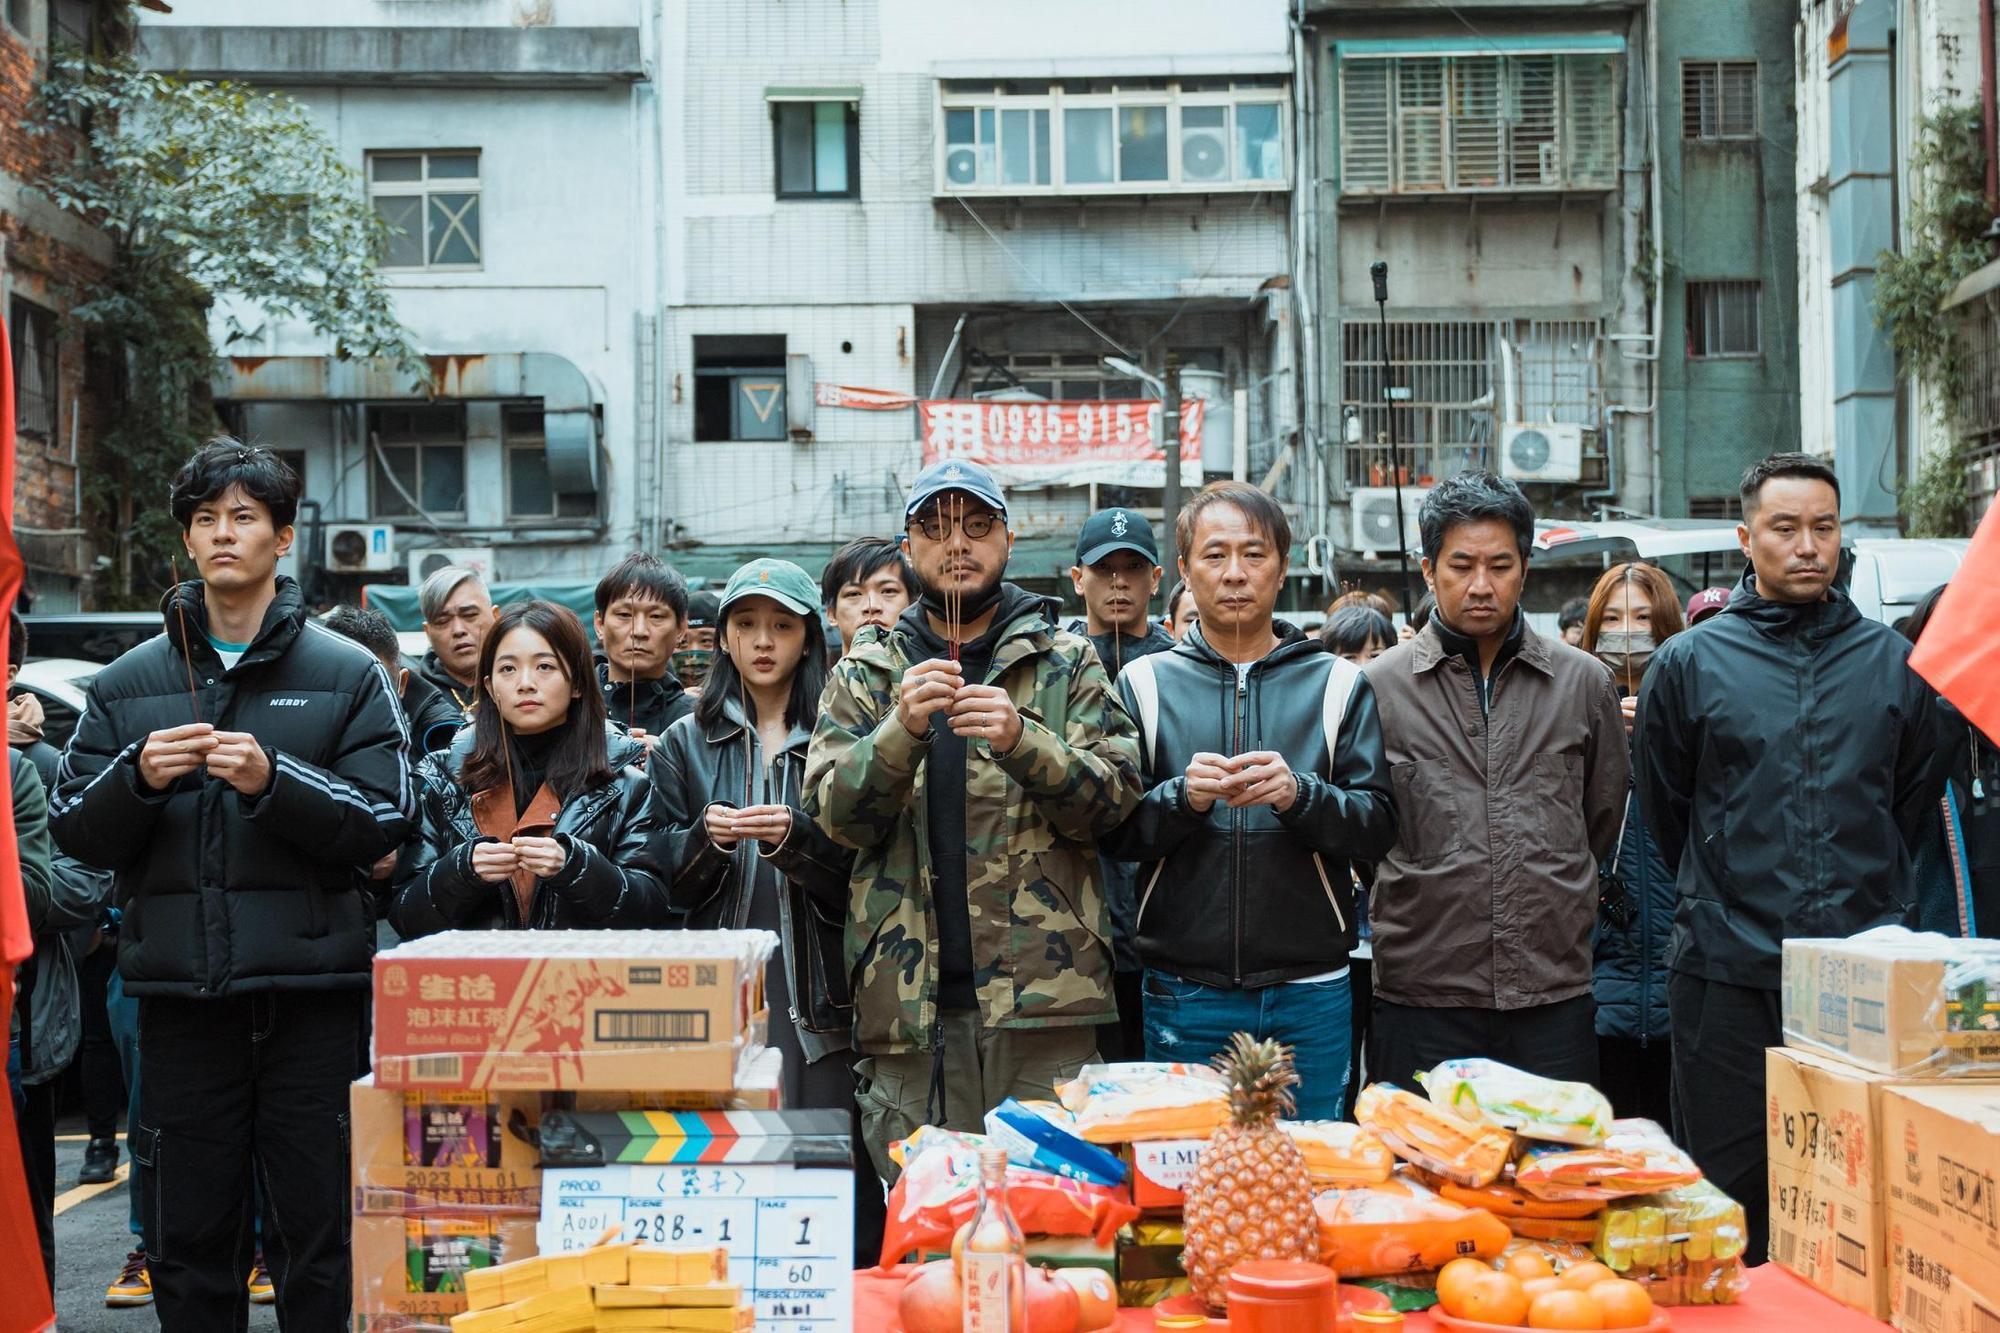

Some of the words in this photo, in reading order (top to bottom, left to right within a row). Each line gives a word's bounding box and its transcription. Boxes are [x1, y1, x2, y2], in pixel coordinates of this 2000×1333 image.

[927, 403, 988, 458] 租
[270, 698, 309, 706] NERDY
[418, 974, 496, 1001] 生活
[406, 1007, 508, 1028] 泡沫紅茶
[629, 1199, 663, 1208] SCENE
[760, 1201, 787, 1209] TAKE
[795, 1216, 812, 1246] 1
[758, 1258, 779, 1267] FPS
[787, 1264, 813, 1284] 60
[757, 1289, 825, 1299] RESOLUTION
